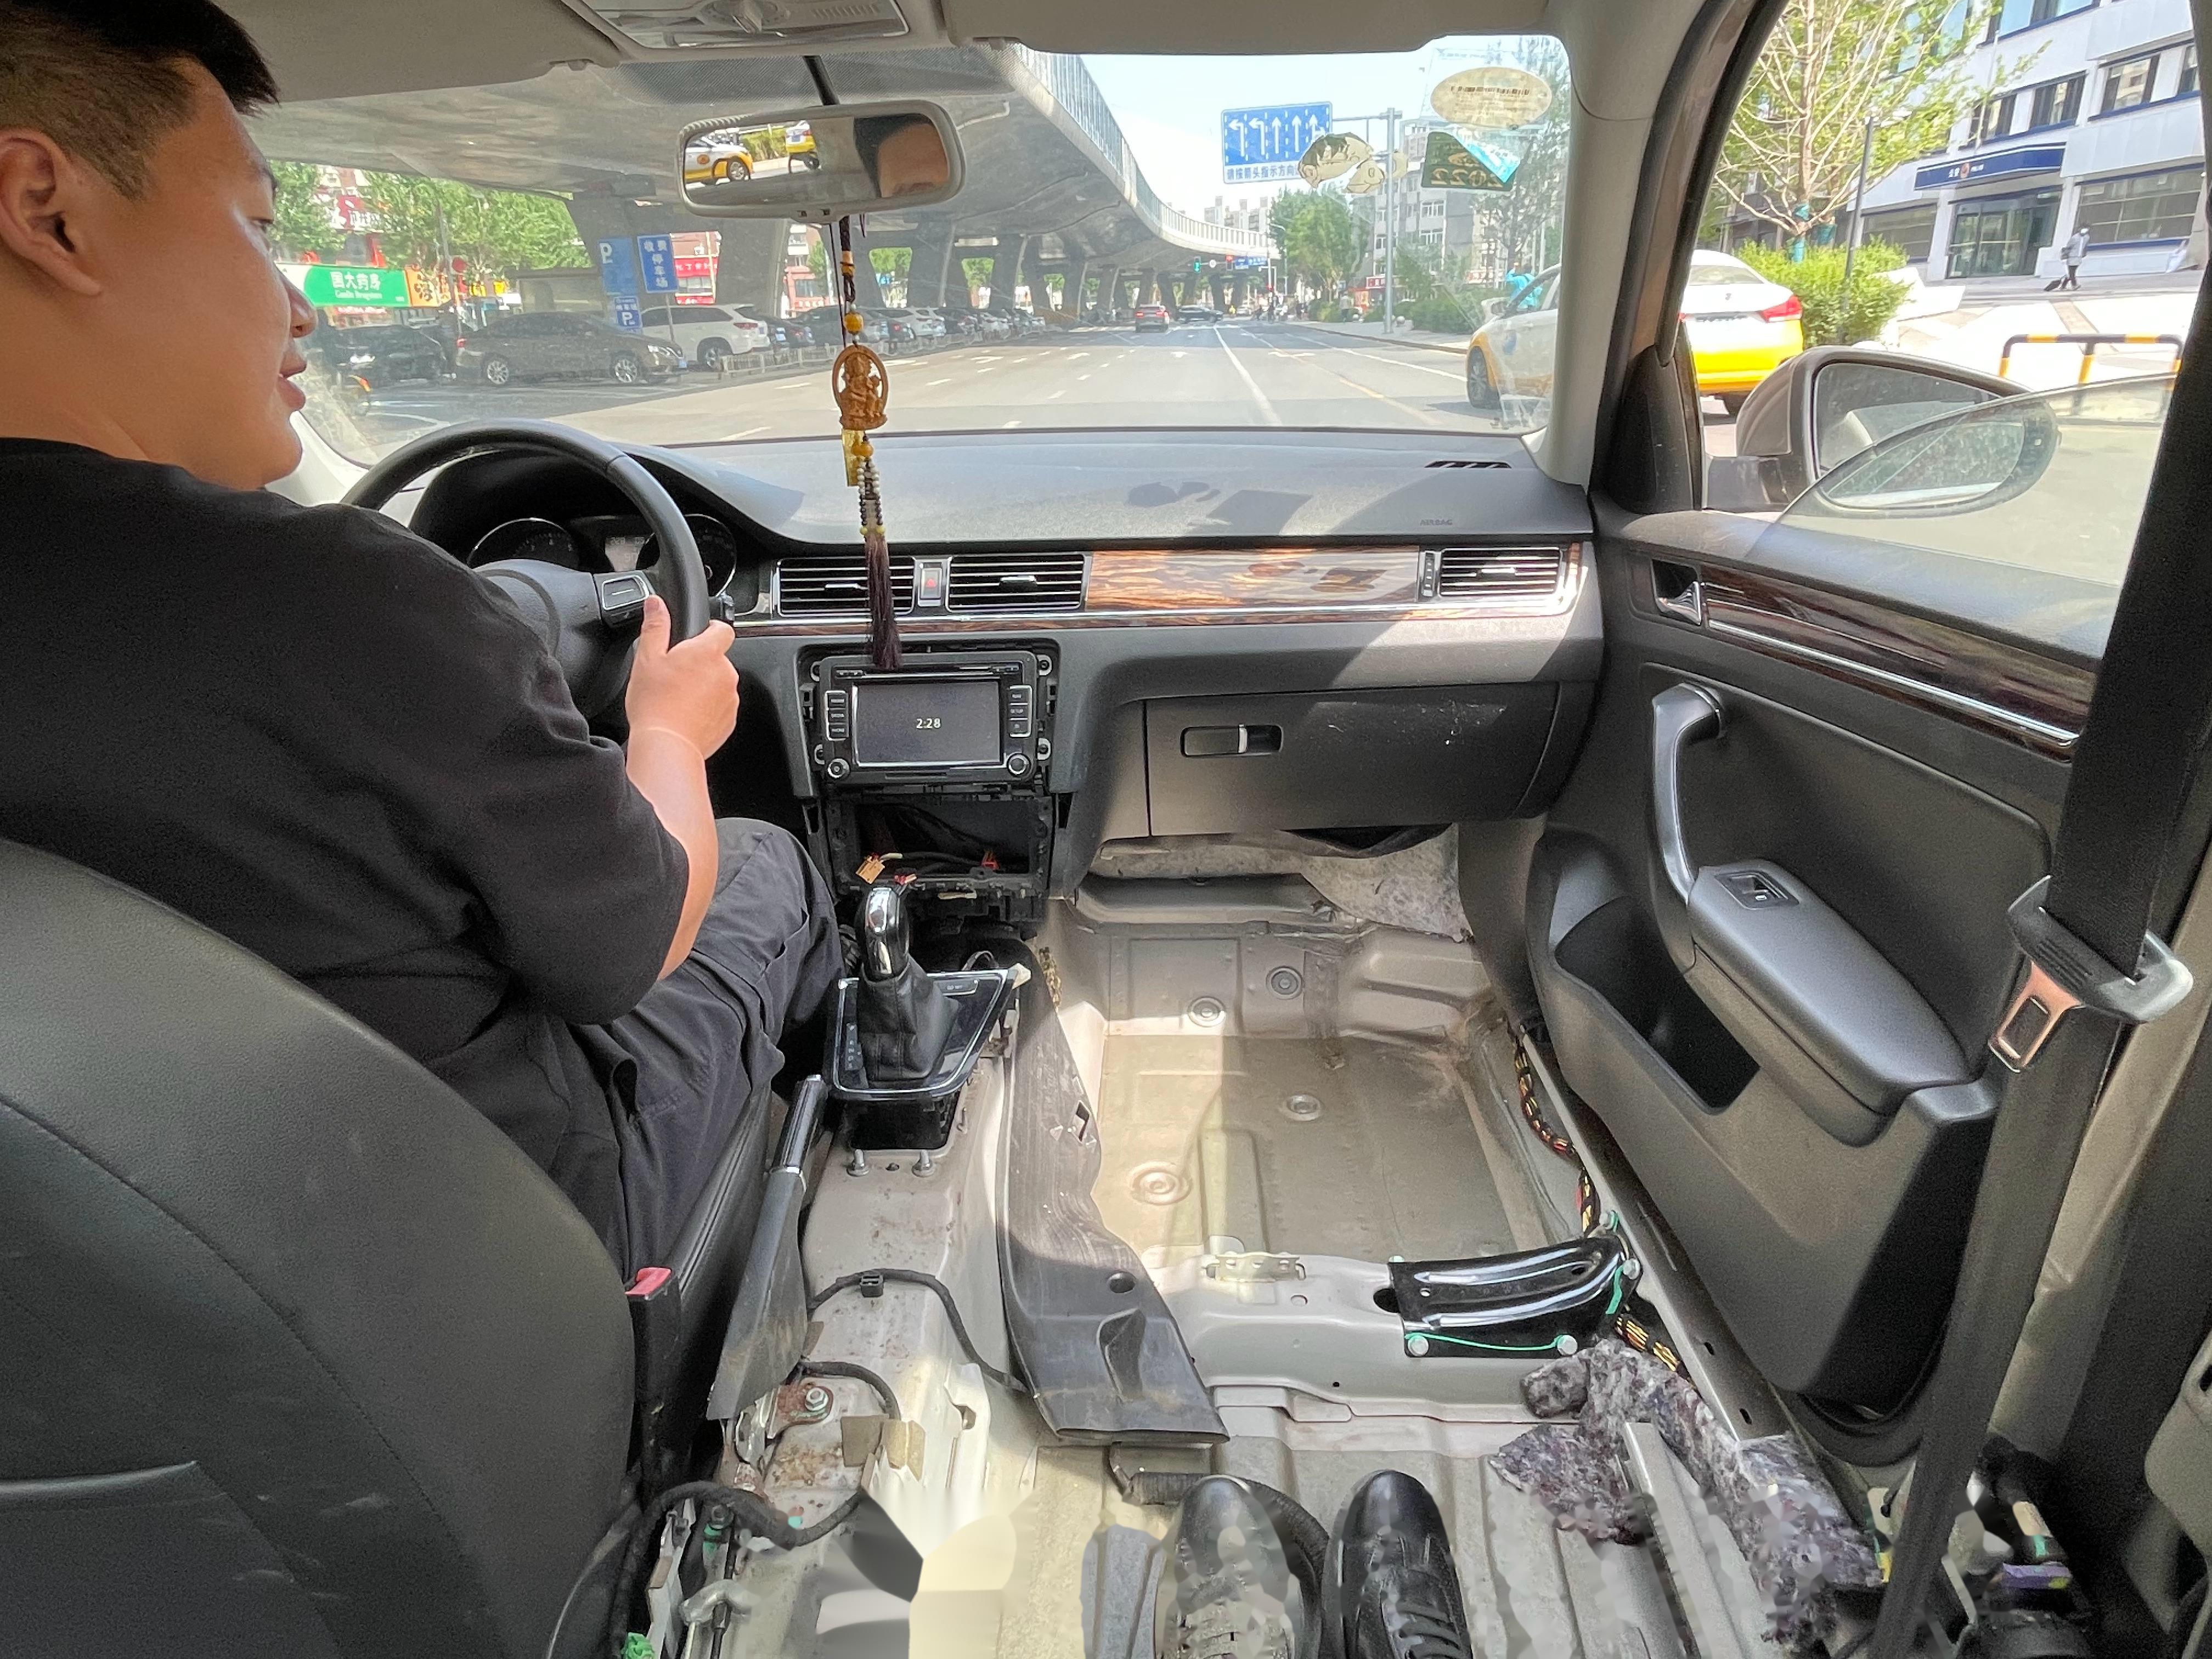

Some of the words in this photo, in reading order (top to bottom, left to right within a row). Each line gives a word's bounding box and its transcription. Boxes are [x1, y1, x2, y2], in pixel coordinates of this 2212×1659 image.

[1227, 165, 1299, 180] 请按箭头指示方向
[916, 718, 941, 729] 2:28
